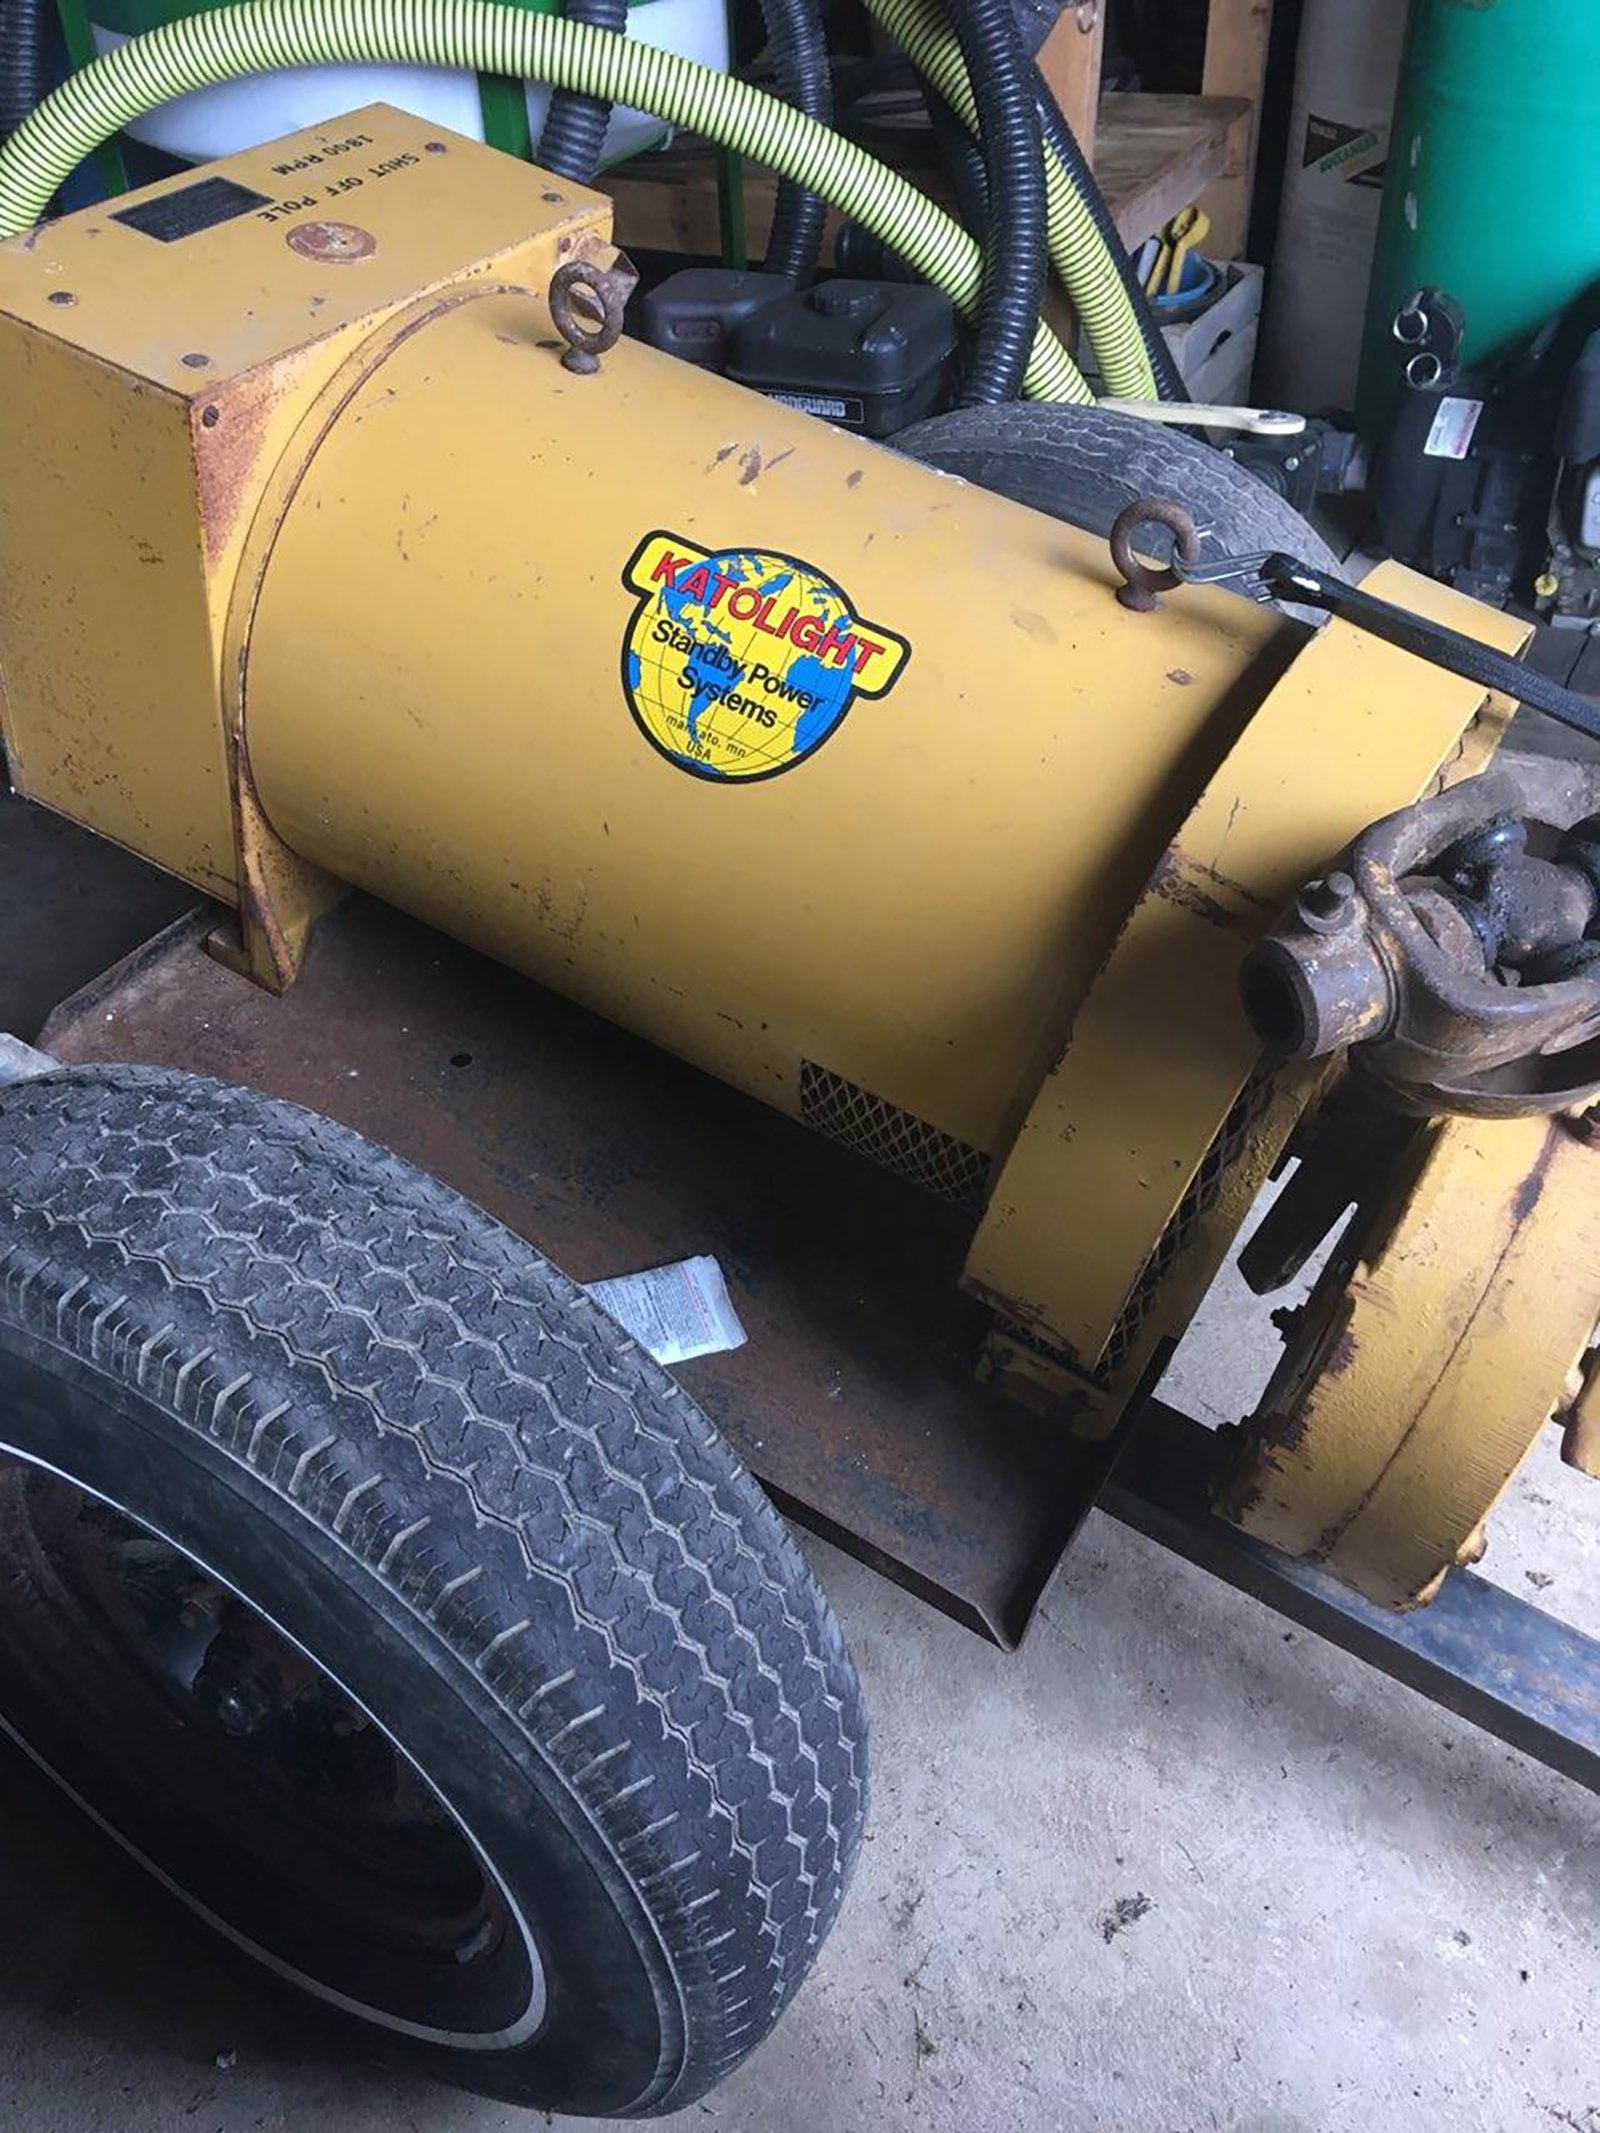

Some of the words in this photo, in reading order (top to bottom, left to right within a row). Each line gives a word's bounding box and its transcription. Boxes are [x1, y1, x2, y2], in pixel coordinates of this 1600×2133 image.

[322, 134, 374, 156] 1800
[271, 153, 324, 176] RPM
[368, 152, 420, 178] SHUT
[324, 176, 364, 197] OFF
[256, 195, 318, 223] POLE
[650, 550, 886, 675] KATOLIGHT
[652, 619, 747, 680] Standby
[747, 662, 826, 713] Power
[677, 667, 778, 729] Systems
[686, 741, 711, 761] USA
